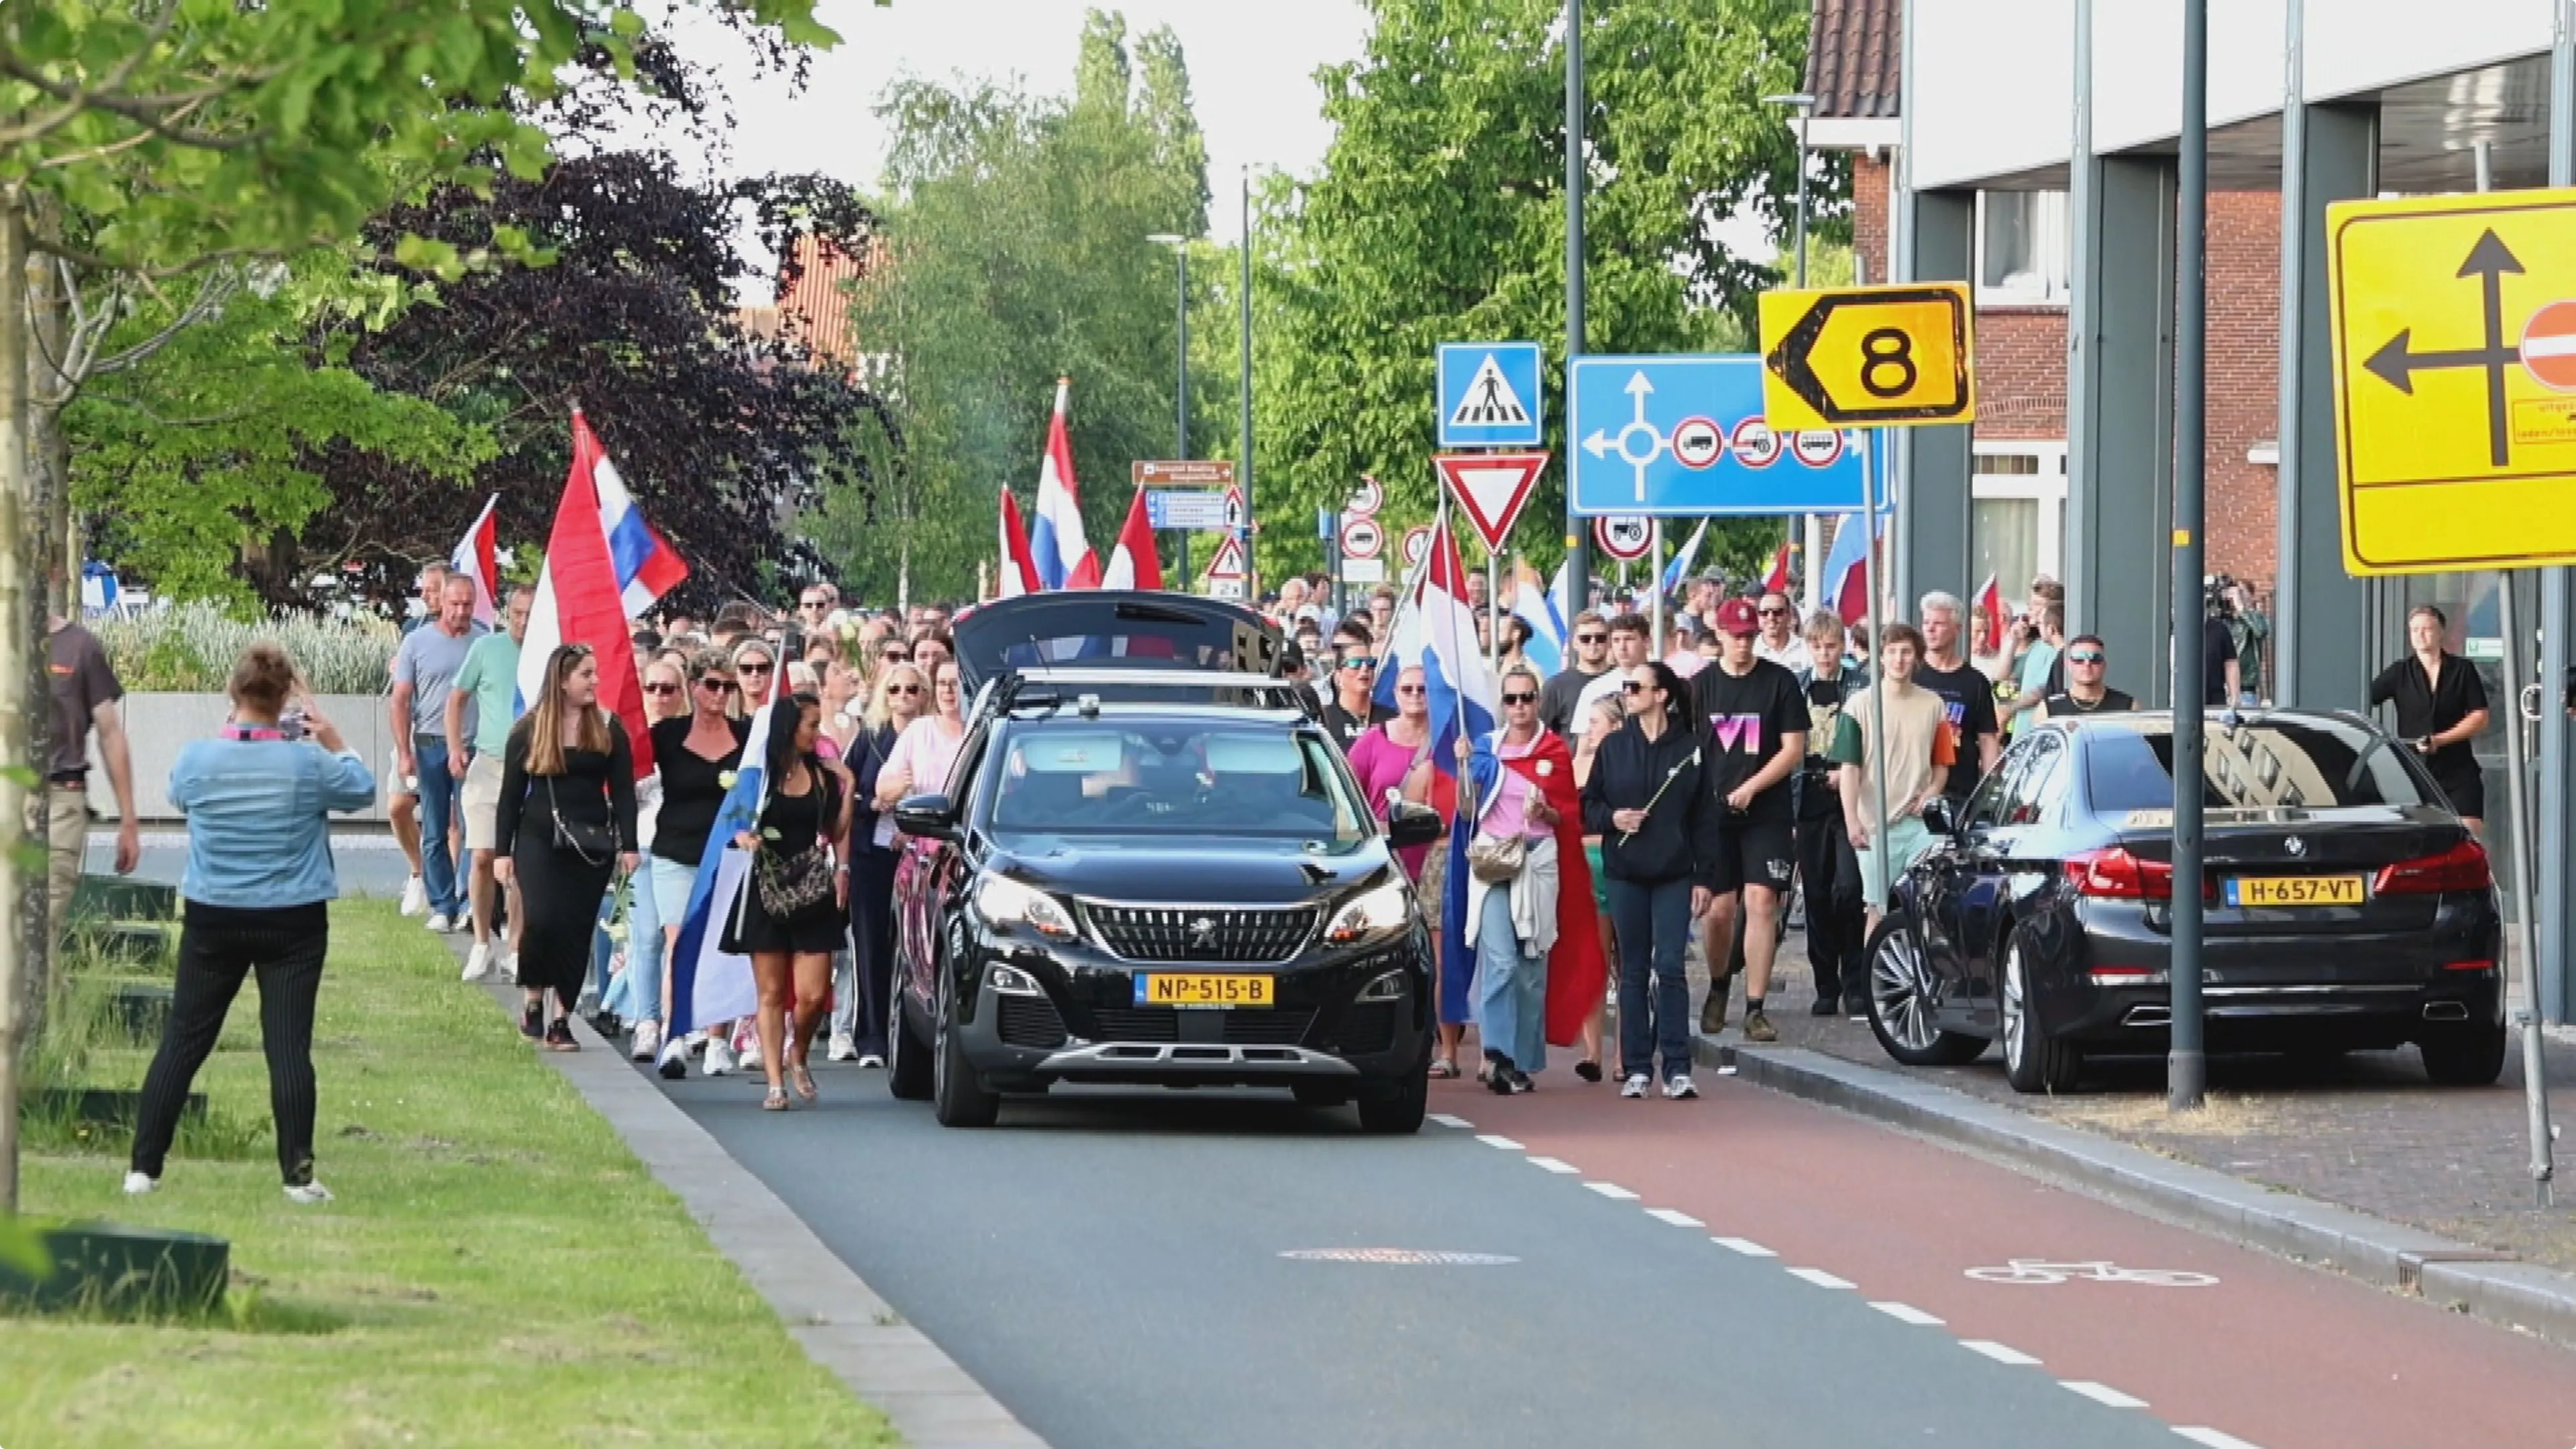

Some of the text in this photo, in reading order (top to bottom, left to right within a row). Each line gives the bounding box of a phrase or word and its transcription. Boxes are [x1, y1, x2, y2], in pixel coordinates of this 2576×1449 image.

[1861, 327, 1917, 398] 8
[2251, 880, 2356, 902] H-657-VT
[1159, 979, 1263, 999] NP-515-B
